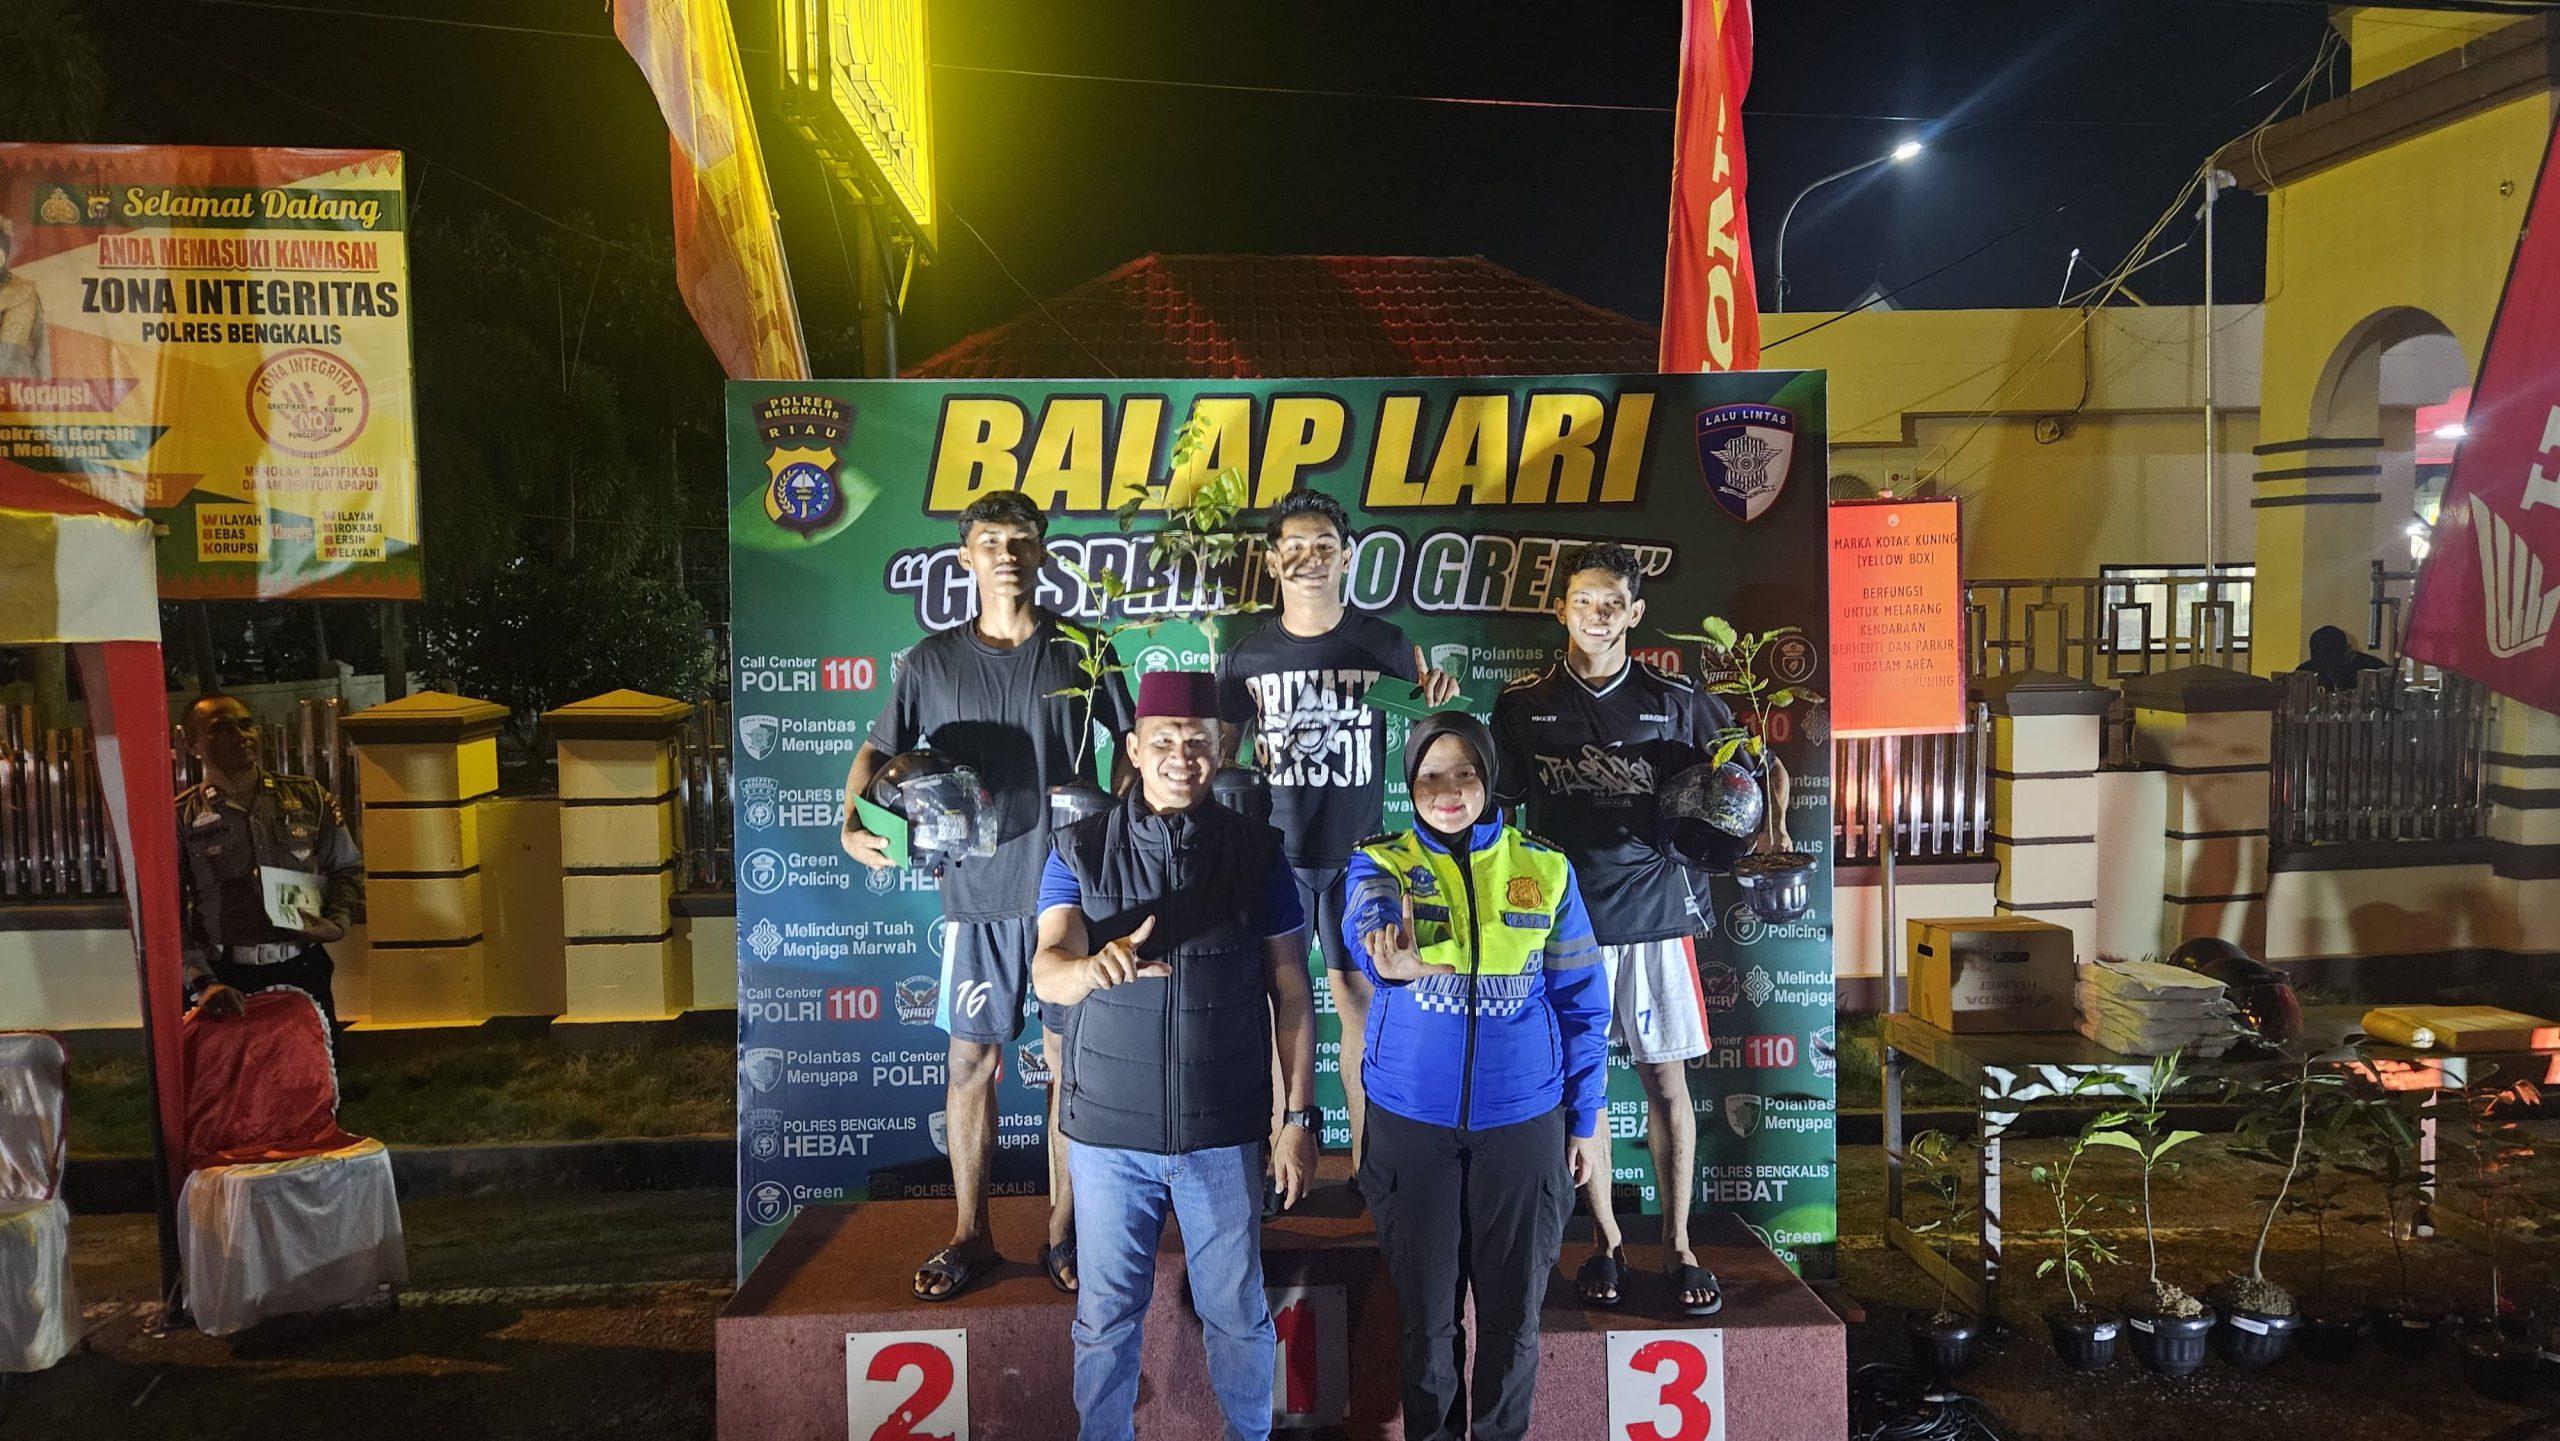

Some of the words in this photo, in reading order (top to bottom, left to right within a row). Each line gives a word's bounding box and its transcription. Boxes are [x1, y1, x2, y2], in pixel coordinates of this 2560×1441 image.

[123, 188, 254, 218] Selamat
[261, 190, 381, 229] Datang
[99, 236, 154, 267] ANDA
[160, 238, 269, 268] MEMASUKI
[276, 240, 378, 269] KAWASAN
[81, 277, 177, 313] ZONA
[186, 278, 399, 316] INTEGRITAS
[142, 322, 222, 343] POLRES
[228, 323, 342, 344] BENGKALIS
[257, 364, 289, 397] ZONA
[288, 357, 358, 396] INTEGRITAS
[10, 381, 91, 407] Korupsi
[770, 396, 833, 410] POLRES
[299, 411, 326, 430] NO
[764, 407, 840, 420] BENGKALIS
[1705, 411, 1737, 426] LALU
[1742, 410, 1787, 424] LINTAS
[69, 426, 136, 442] Bersih
[14, 443, 108, 459] Melayani
[928, 397, 1346, 512] BALAP
[1365, 393, 1655, 507] LARI
[202, 514, 262, 525] WILAYAH
[323, 510, 374, 521] WILAYAH
[203, 529, 246, 540] BEBAS
[323, 524, 383, 534] BIROKRASI
[324, 535, 366, 545] BERSIH
[1834, 537, 1872, 551] MARKA
[1876, 535, 1910, 548] KOTAK
[1915, 533, 1958, 546] KUNING
[203, 543, 259, 554] KORUPSI
[325, 548, 380, 558] MELAYANI
[1857, 552, 1903, 569] (YELLOW
[1909, 551, 1934, 566] BOX)
[1863, 585, 1923, 600] BERFUNGSI
[1843, 606, 1879, 619] UNTUK
[1884, 603, 1942, 616] MELARANG
[1860, 622, 1926, 636] KENDARAAN
[1471, 646, 1544, 660] Polantas
[1832, 642, 1883, 656] BERHENTI
[1888, 640, 1911, 653] DAN
[1916, 638, 1955, 652] PARKIR
[740, 656, 765, 668] Call
[769, 656, 817, 668] Center
[1853, 660, 1901, 673] DIDALAM
[1906, 657, 1934, 670] AREA
[741, 671, 817, 692] POLRI
[825, 659, 873, 690] 110
[782, 718, 856, 733] Polantas
[782, 738, 853, 755] Menyapa
[779, 789, 832, 802] POLRES
[779, 804, 845, 827] HEBA
[788, 853, 838, 868] Green
[788, 870, 850, 889] Policing
[785, 922, 869, 940] Melindungi
[872, 921, 914, 936] Tuah
[1768, 925, 1827, 942] Policing
[783, 941, 849, 960] Menjaga
[852, 939, 917, 956] Marwah
[746, 988, 771, 1000] Call
[777, 987, 823, 999] Center
[955, 979, 993, 1018] 16
[748, 1002, 822, 1024] POLRI
[830, 990, 878, 1019] 110
[1637, 1009, 1652, 1036] 7
[787, 1051, 861, 1064] Polantas
[871, 1052, 895, 1063] Call
[900, 1051, 946, 1063] Center
[1749, 1037, 1794, 1067] 110
[787, 1070, 858, 1086] Menyapa
[872, 1065, 946, 1087] POLRI
[1764, 1096, 1836, 1111] Polantas
[783, 1119, 837, 1133] POLRES
[840, 1117, 917, 1131] BENGKALIS
[1765, 1116, 1833, 1133] Menyapa
[783, 1134, 874, 1157] HEBAT
[1702, 1166, 1753, 1179] POLRES
[1756, 1165, 1830, 1178] BENGKALIS
[793, 1185, 844, 1199] Green
[1702, 1180, 1789, 1202] HEBAT
[1773, 1229, 1822, 1243] Green
[1274, 1298, 1317, 1415] 1
[866, 1342, 956, 1441] 2
[1625, 1339, 1712, 1441] 3
